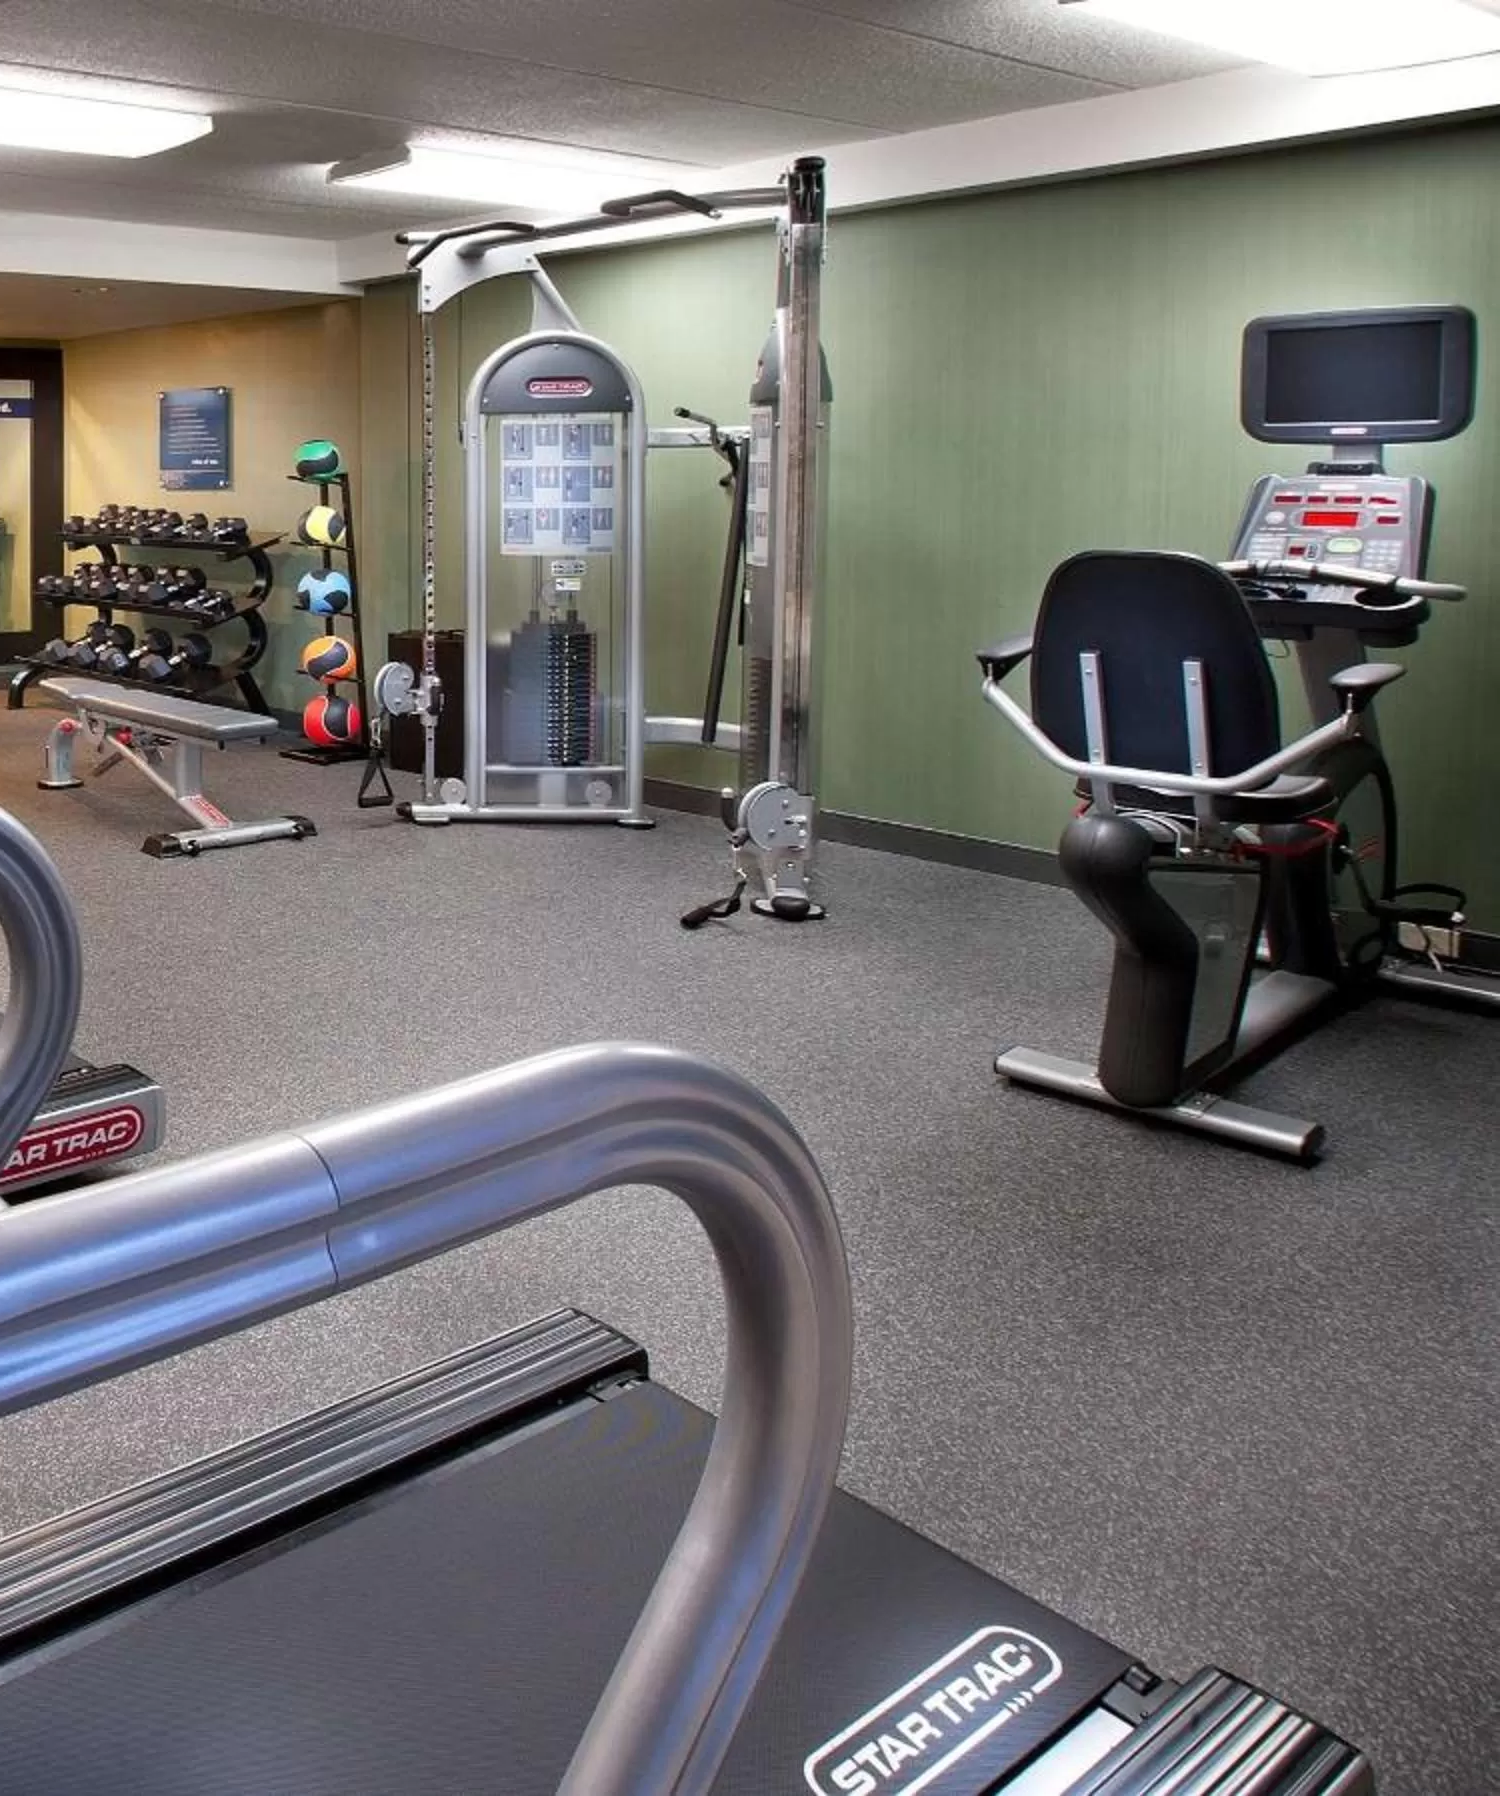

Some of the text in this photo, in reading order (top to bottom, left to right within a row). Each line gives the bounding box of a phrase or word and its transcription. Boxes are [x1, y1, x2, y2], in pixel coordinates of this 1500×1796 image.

[3, 1121, 130, 1171] AR TRAC
[831, 1643, 1034, 1796] STAR TRAC
